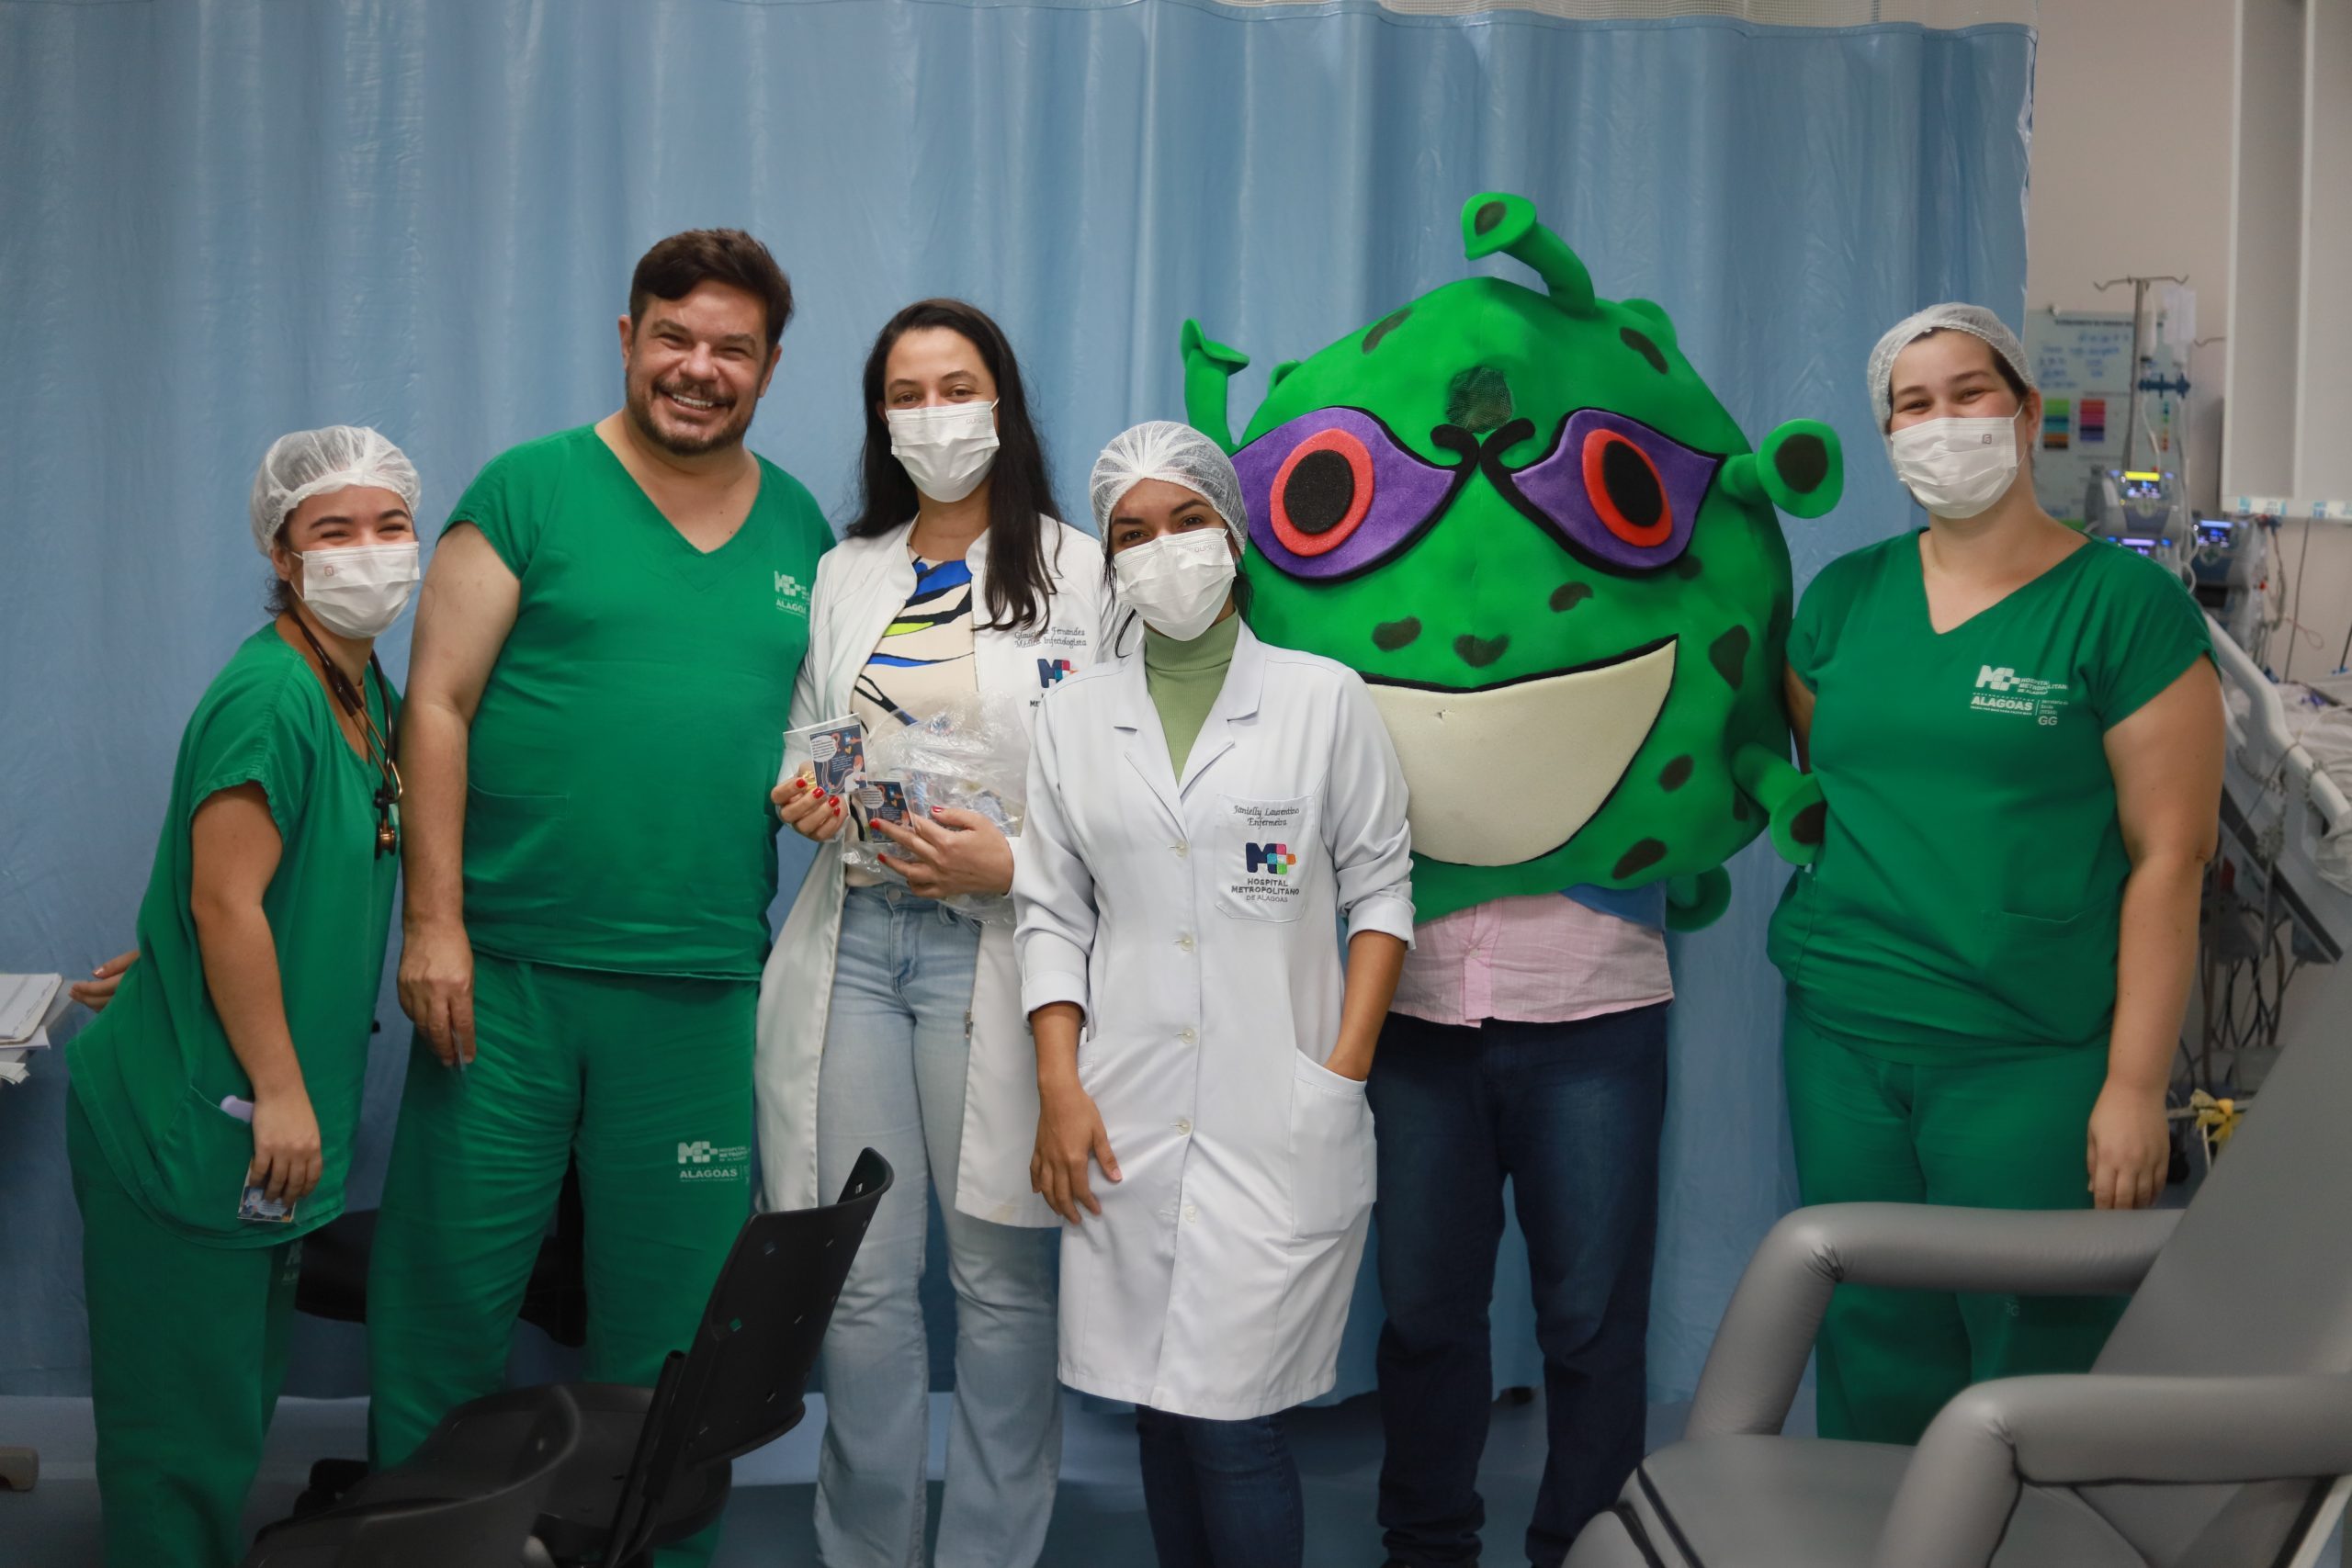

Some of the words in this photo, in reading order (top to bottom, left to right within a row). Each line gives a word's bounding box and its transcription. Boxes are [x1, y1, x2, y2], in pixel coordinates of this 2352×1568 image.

[776, 599, 806, 615] ALAGO
[1052, 626, 1085, 637] Fernandes
[2018, 682, 2069, 691] METROPLITAN
[1971, 695, 2033, 711] ALAGOAS
[2038, 716, 2058, 726] GG
[1264, 807, 1300, 817] Laurentino
[1248, 818, 1287, 829] Enfermeira
[1247, 878, 1289, 887] HOSPITAL
[1231, 886, 1300, 896] METROPOLITANO
[1257, 895, 1288, 903] ALAGOAS
[680, 1168, 738, 1179] ALAGOAS
